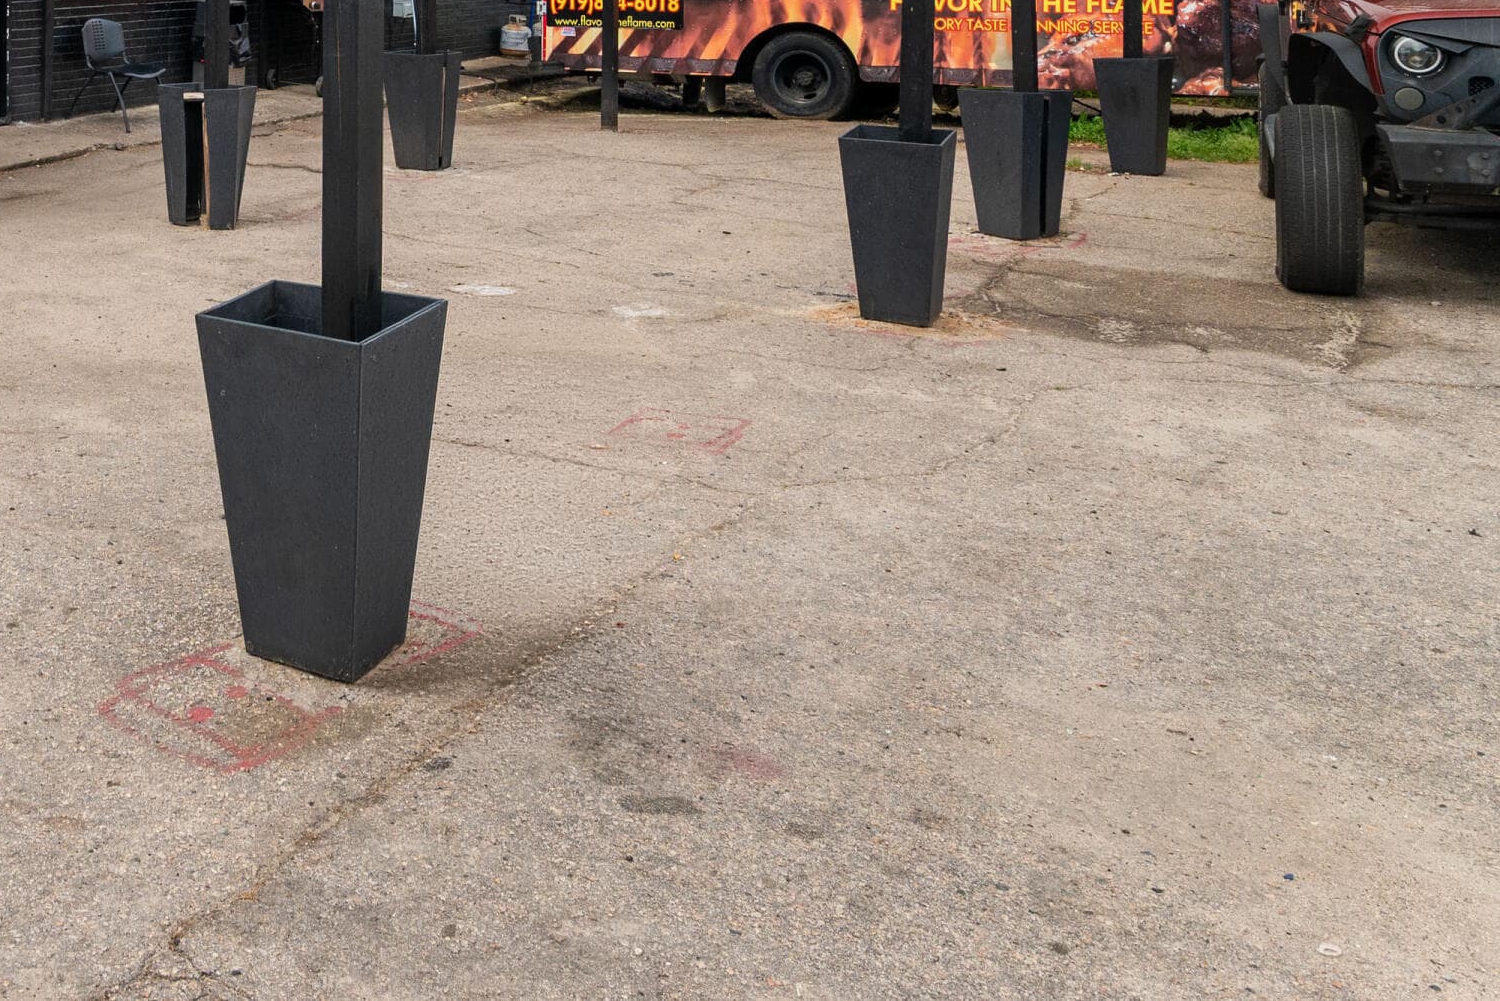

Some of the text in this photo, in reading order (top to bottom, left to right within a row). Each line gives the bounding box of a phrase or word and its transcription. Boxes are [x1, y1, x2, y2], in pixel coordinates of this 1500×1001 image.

[554, 14, 676, 29] www.flavoeflame.com
[966, 18, 1007, 32] TASTE
[1035, 19, 1089, 34] NNING
[1093, 20, 1153, 35] SERE
